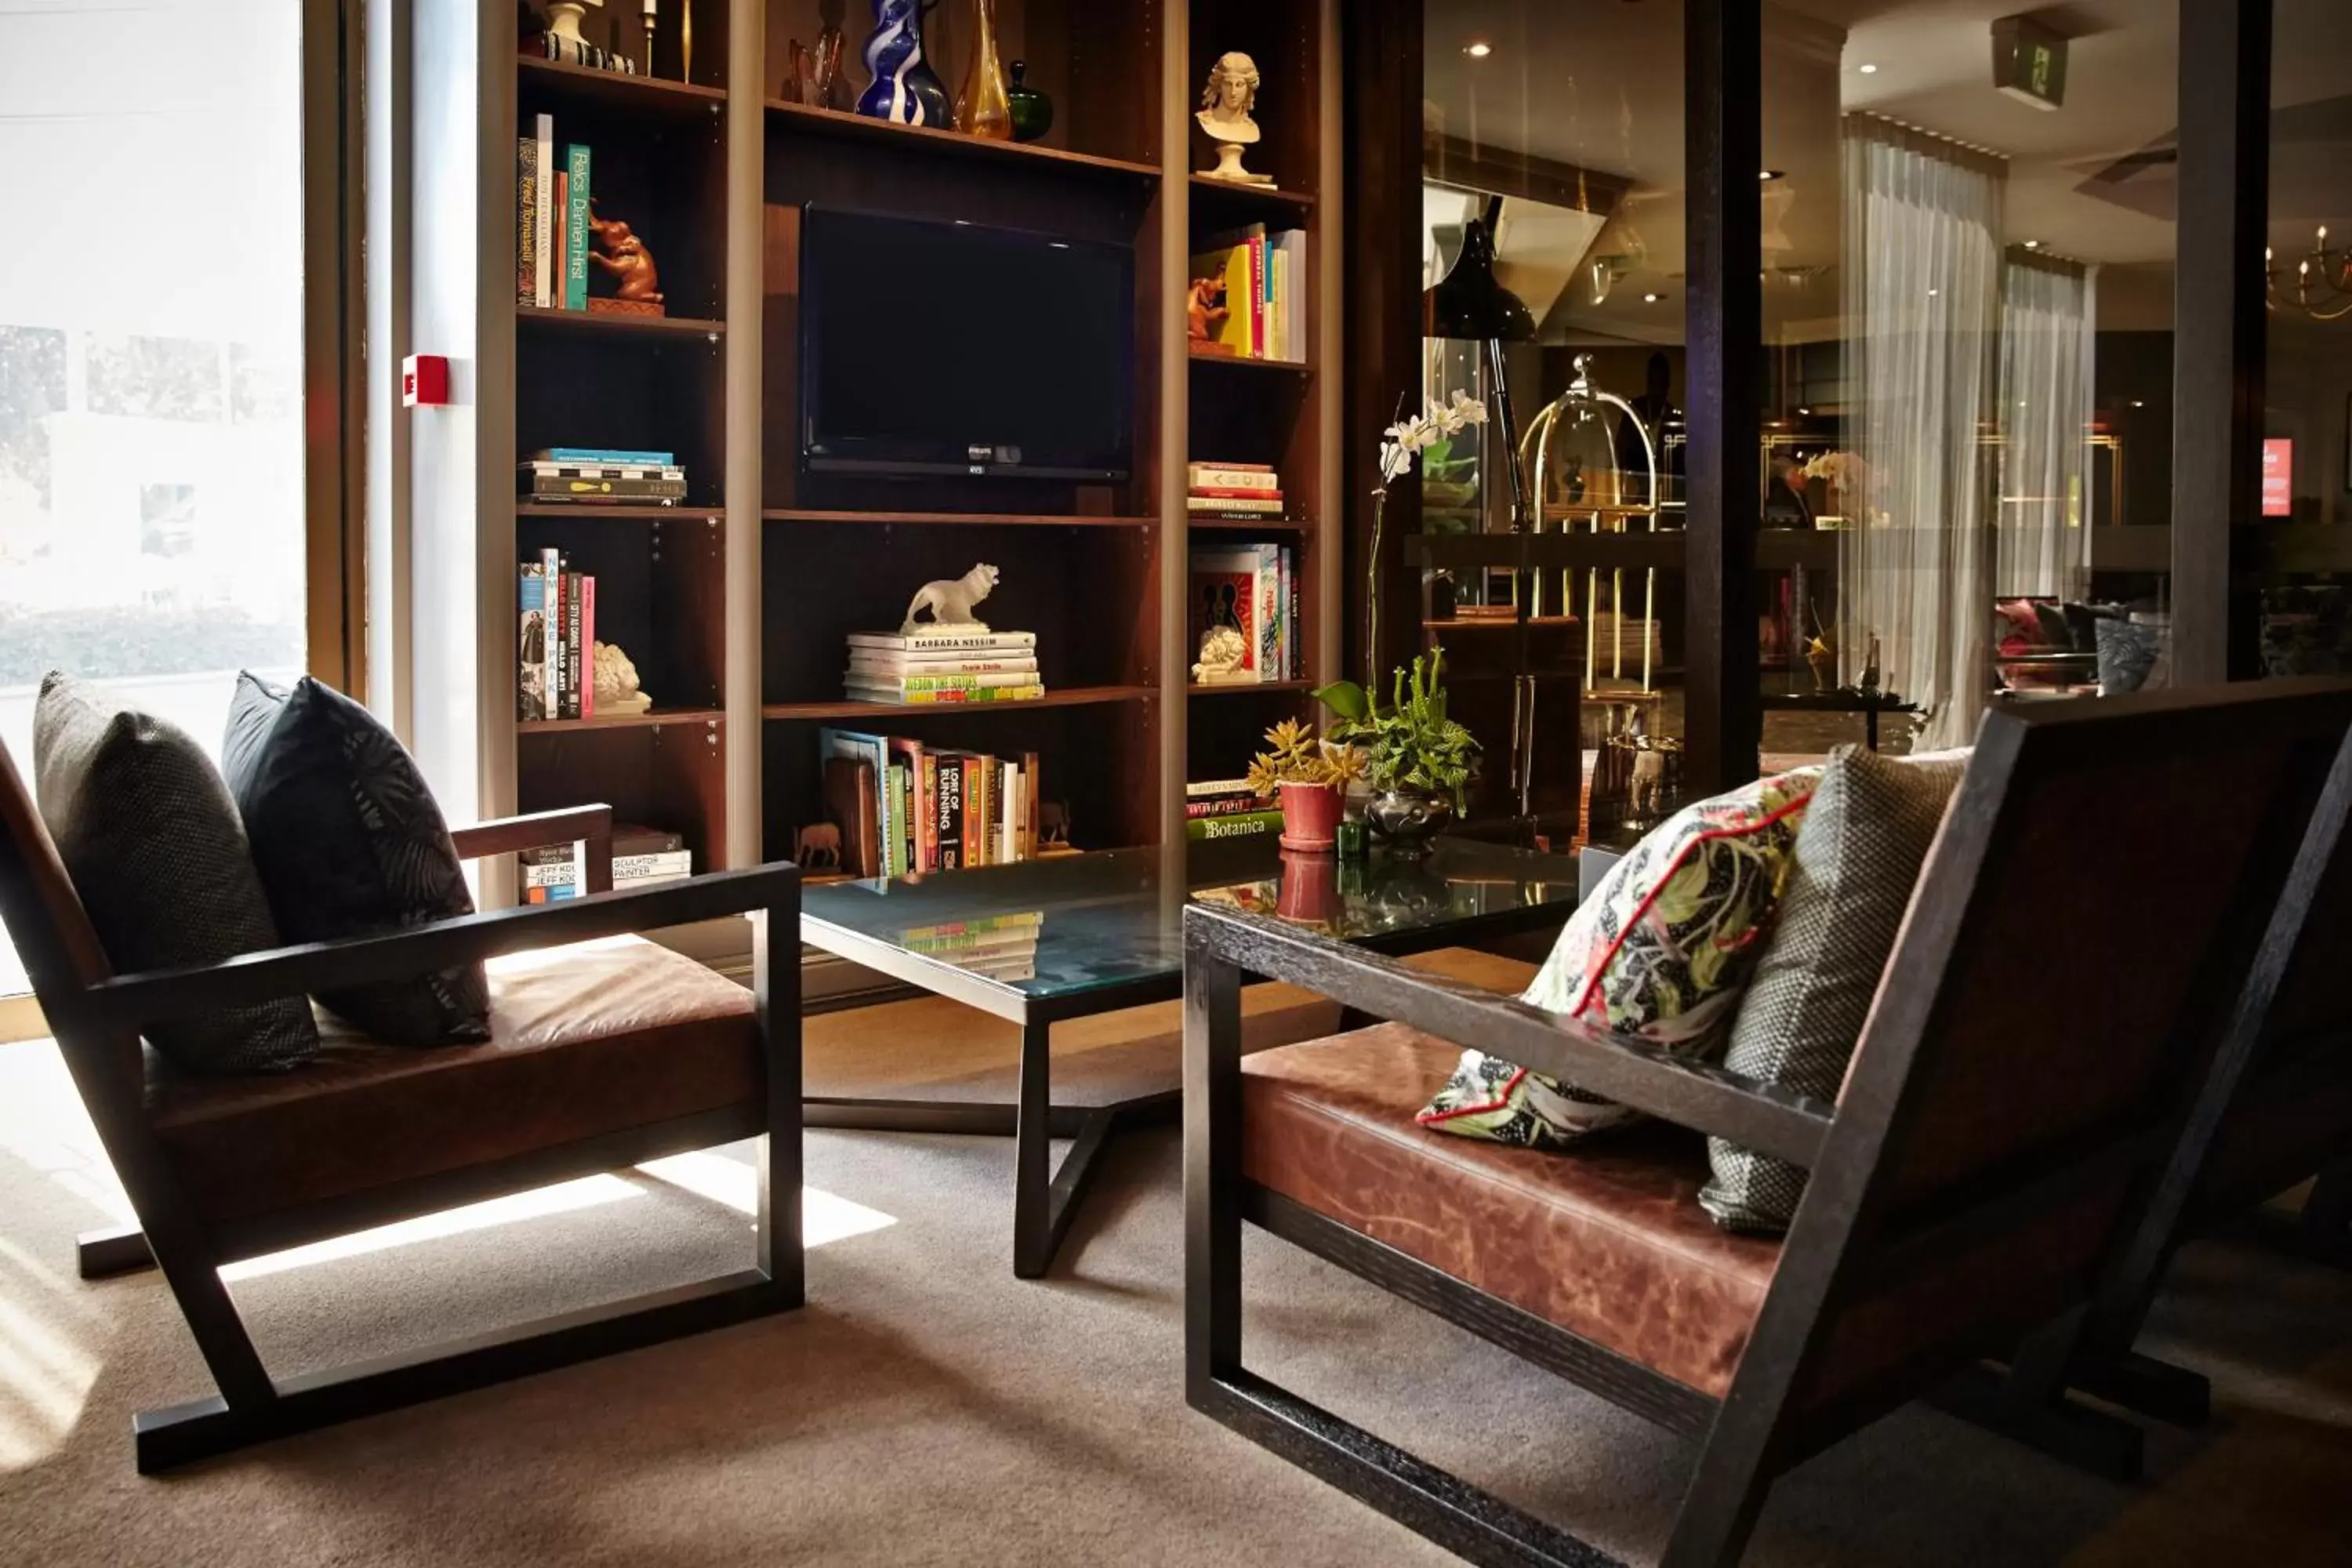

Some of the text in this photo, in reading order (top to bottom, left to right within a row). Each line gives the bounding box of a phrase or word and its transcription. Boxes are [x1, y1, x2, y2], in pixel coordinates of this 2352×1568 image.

[571, 153, 587, 279] Relics Damien Hirst
[547, 599, 556, 641] JUNE
[915, 640, 960, 648] BARBARA
[941, 768, 950, 830] RUNNING
[950, 768, 959, 810] LORE OF
[1210, 816, 1265, 838] Botanica
[614, 857, 659, 868] SCULPTOR
[614, 868, 650, 878] PAINTER
